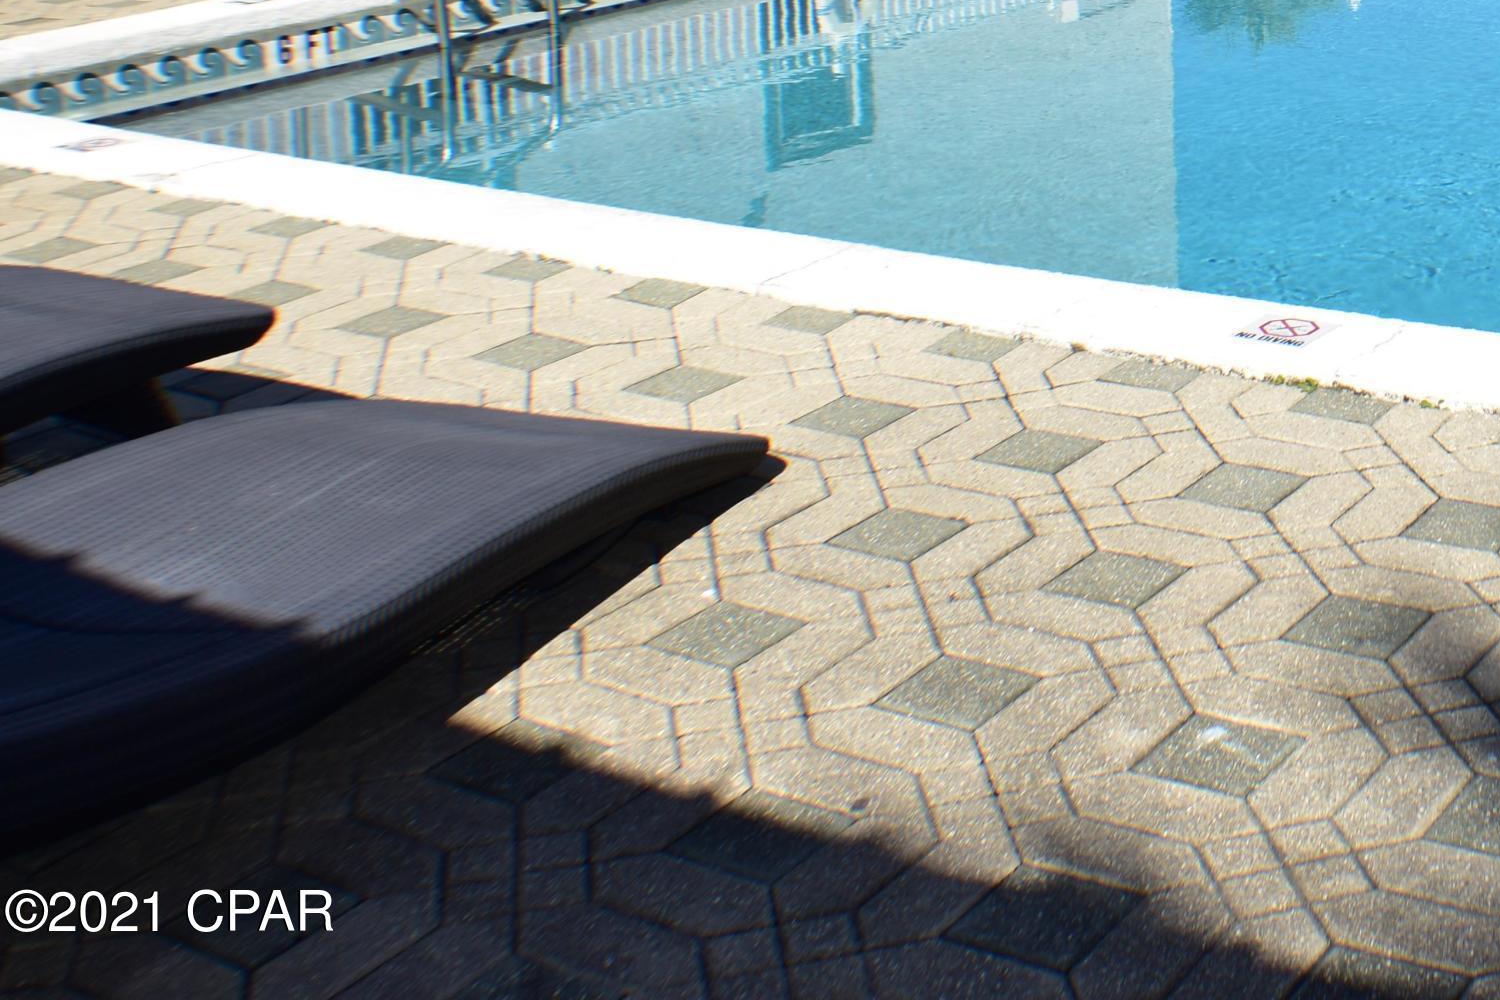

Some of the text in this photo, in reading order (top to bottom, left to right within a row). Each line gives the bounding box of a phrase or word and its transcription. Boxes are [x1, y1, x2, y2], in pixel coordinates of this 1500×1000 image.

[277, 25, 337, 64] 6 FT
[1234, 331, 1305, 348] NO DIVING
